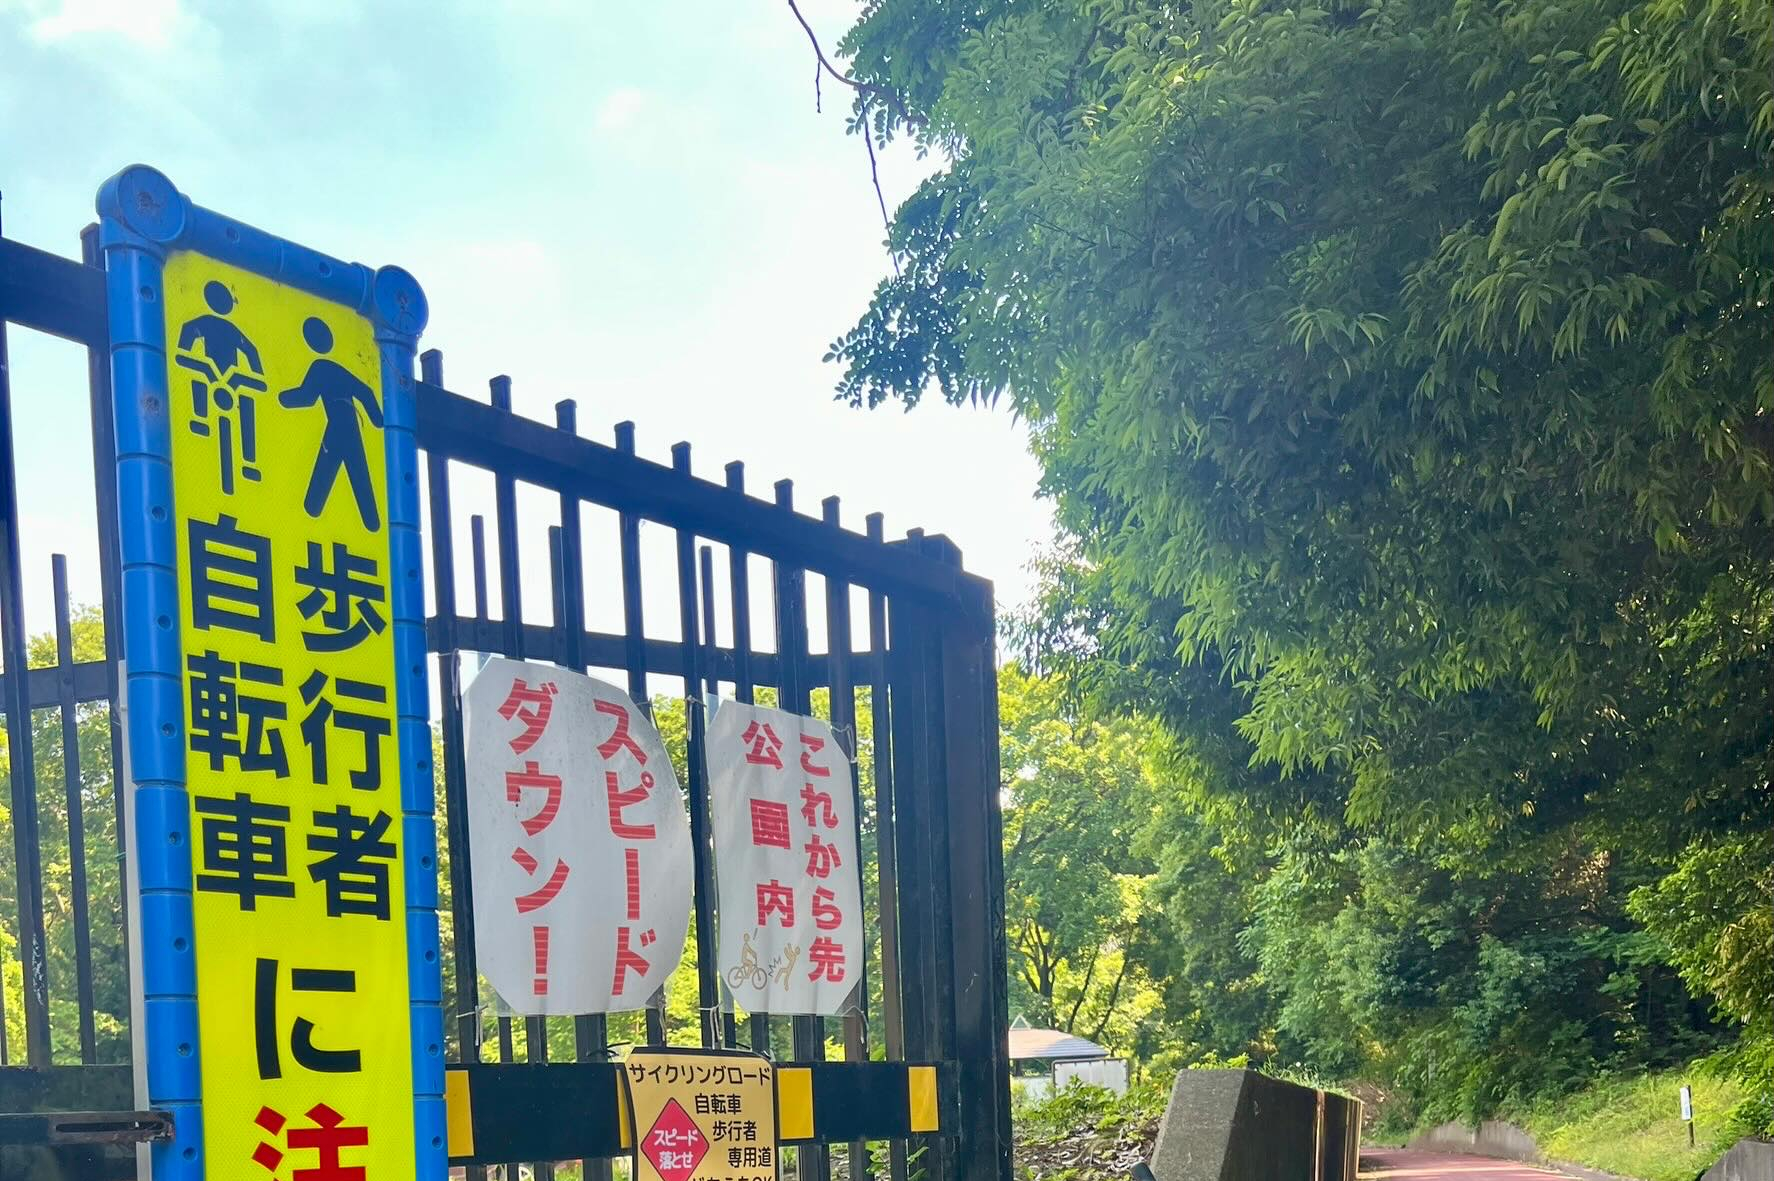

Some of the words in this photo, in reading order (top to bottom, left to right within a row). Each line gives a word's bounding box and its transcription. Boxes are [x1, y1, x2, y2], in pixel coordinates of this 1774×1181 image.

[188, 513, 295, 912] 自転車
[294, 541, 398, 921] 歩行者
[741, 719, 796, 928] 公園内
[593, 698, 657, 996] スピード
[800, 732, 846, 983] これから先
[628, 1063, 771, 1086] サイクリングロード
[694, 1092, 742, 1115] 自転車
[654, 1128, 698, 1147] スピード
[712, 1120, 757, 1142] 歩行者
[659, 1150, 694, 1170] 落とせ
[727, 1146, 772, 1169] 専用道
